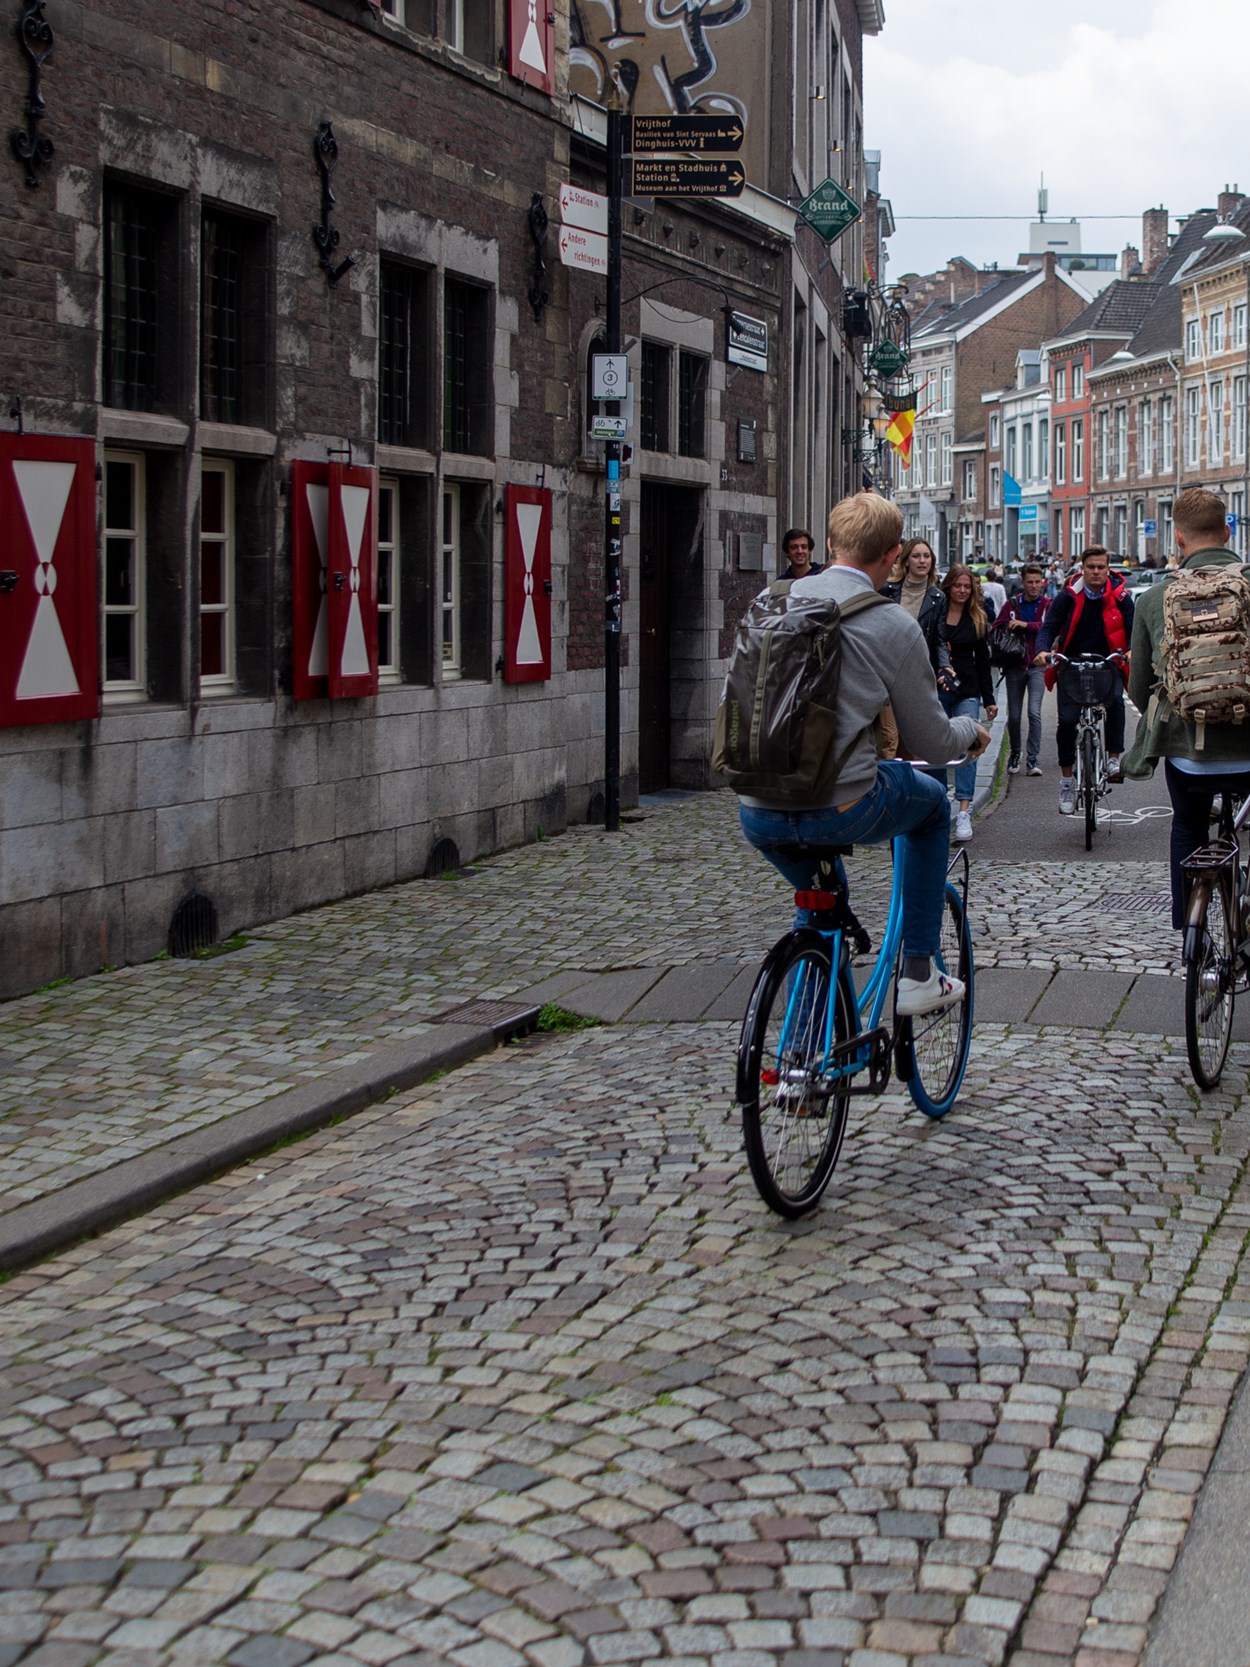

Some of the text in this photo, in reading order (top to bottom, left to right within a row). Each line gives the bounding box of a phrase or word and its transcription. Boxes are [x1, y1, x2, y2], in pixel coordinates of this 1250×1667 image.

[636, 120, 672, 130] Vrijthof
[635, 139, 697, 149] Dinghuis-VVV
[636, 163, 662, 172] Markt
[678, 163, 718, 172] Stadhuis
[635, 173, 669, 182] Station
[691, 184, 718, 193] Vrijthof
[575, 193, 593, 207] Station
[809, 198, 848, 212] Brand
[567, 232, 587, 246] Andere
[574, 251, 600, 267] richtingen
